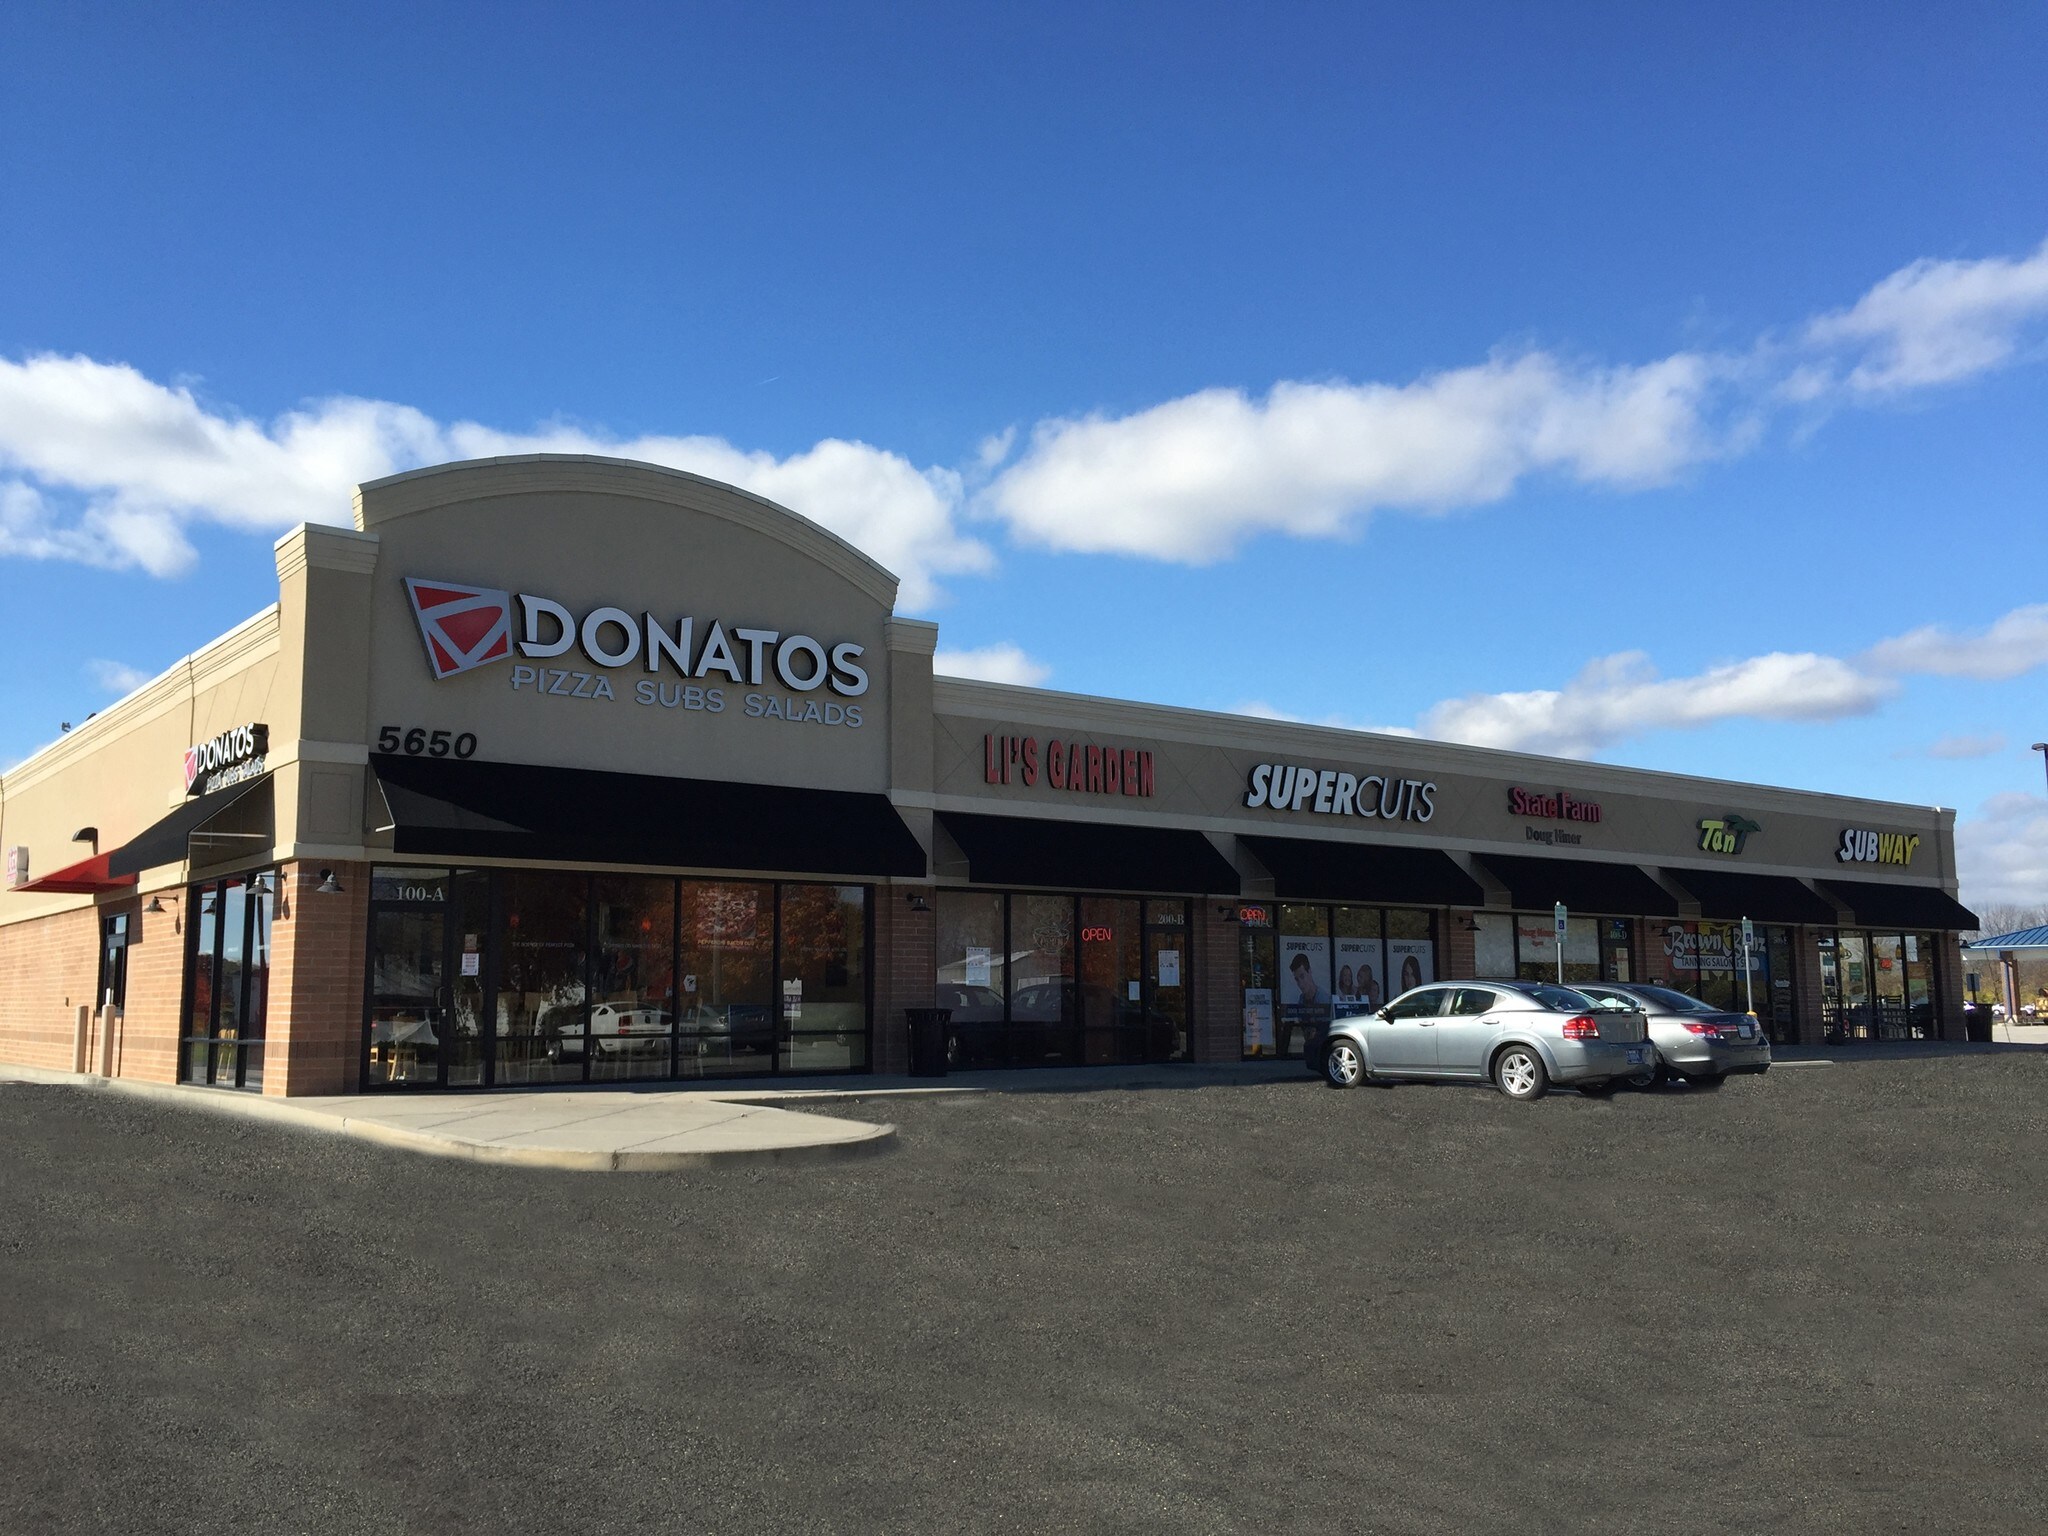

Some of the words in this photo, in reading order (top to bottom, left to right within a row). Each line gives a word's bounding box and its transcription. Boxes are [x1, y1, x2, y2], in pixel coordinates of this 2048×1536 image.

[513, 593, 869, 698] DONATOS
[511, 664, 615, 702] PIZZA
[635, 680, 726, 714] SUBS
[744, 693, 864, 728] SALADS
[198, 722, 256, 774] DONATOS
[378, 725, 477, 759] 5650
[985, 734, 1039, 787] LI'S
[1047, 739, 1156, 797] GARDEN
[1244, 764, 1438, 823] SUPERCUTS
[1509, 786, 1558, 818] State
[1559, 792, 1603, 822] Farm
[1526, 826, 1553, 845] Doug
[1839, 828, 1920, 865] SUBWAY
[397, 887, 446, 902] 100-A
[1240, 908, 1267, 920] OPEN
[1081, 927, 1113, 942] OPEN
[1663, 925, 1722, 958] Brown
